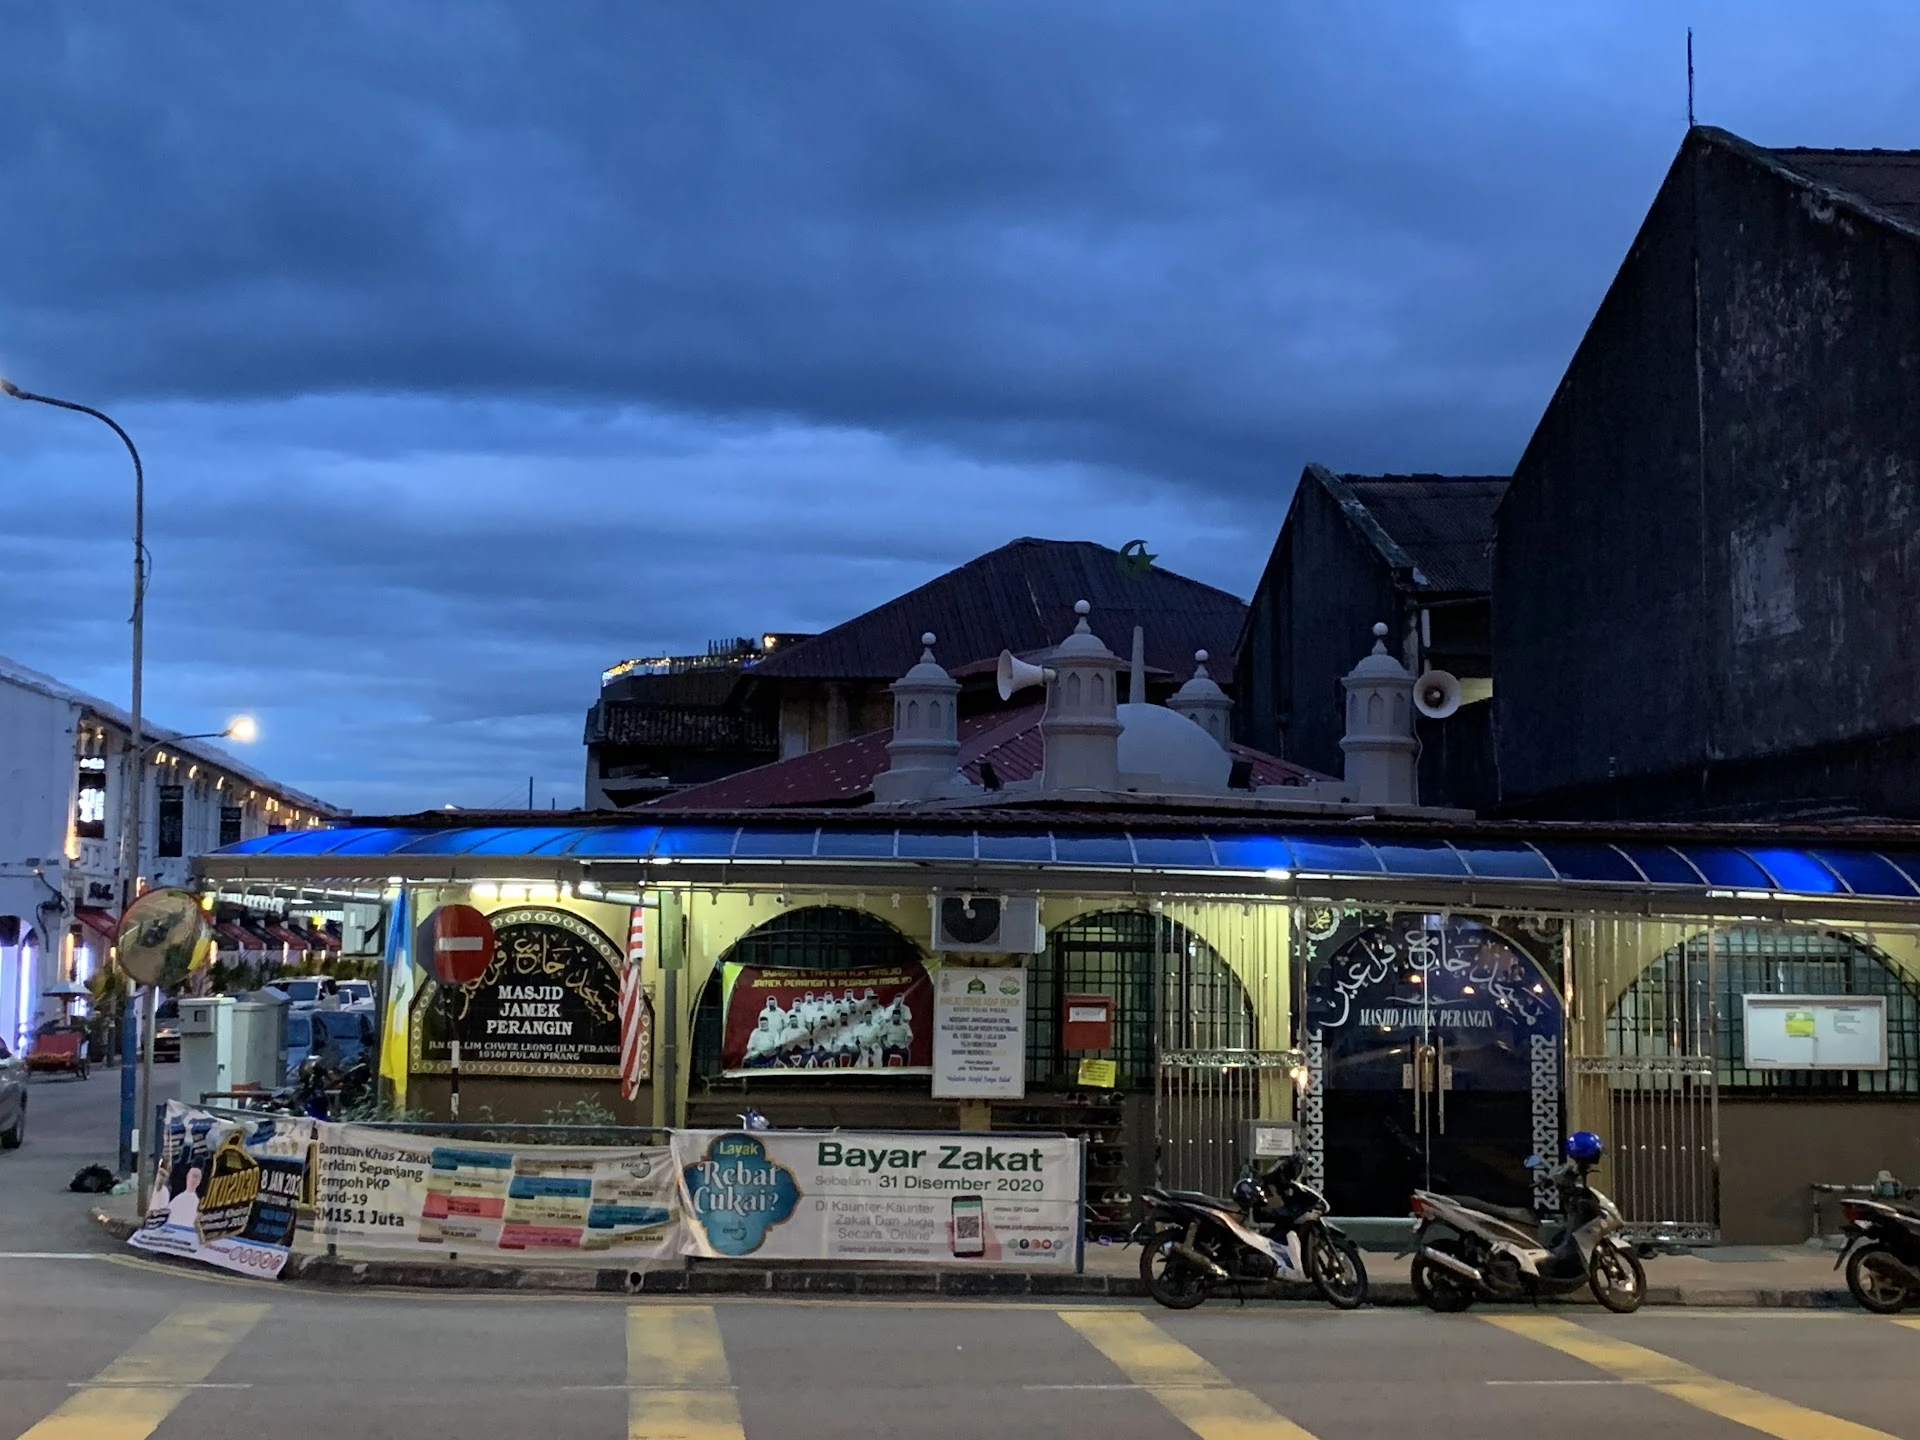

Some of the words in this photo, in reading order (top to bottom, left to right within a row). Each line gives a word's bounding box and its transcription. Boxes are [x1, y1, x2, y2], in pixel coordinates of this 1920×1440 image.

[752, 979, 782, 988] JAMEK
[784, 979, 828, 988] PERANGIN
[838, 978, 878, 987] PEGAWAI
[879, 976, 912, 985] MASJID
[498, 985, 564, 1000] MASJID
[499, 1002, 561, 1018] JAMEK
[1359, 1008, 1399, 1027] MASJID
[1399, 1008, 1437, 1028] JAMEK
[1439, 1009, 1493, 1028] PERANGIN
[486, 1019, 573, 1036] PERANGIN
[429, 1040, 444, 1050] JLN
[464, 1041, 481, 1050] LIM
[484, 1041, 518, 1051] CHWEE
[521, 1043, 553, 1052] LEONG
[555, 1043, 575, 1053] (JLN
[479, 1050, 507, 1059] 10100
[509, 1051, 541, 1060] PULAU
[543, 1052, 580, 1061] PINANG
[319, 1143, 364, 1158] Bantuan
[365, 1147, 395, 1161] Khas
[397, 1150, 432, 1165] Zakat
[719, 1142, 759, 1157] Layak
[818, 1142, 927, 1174] Bayar
[937, 1145, 1043, 1172] Zakat
[260, 1169, 268, 1190] 8
[267, 1170, 285, 1192] JAN
[359, 1161, 424, 1183] Sepanjang
[697, 1160, 780, 1190] Rebat
[317, 1173, 363, 1190] Tempoh
[366, 1177, 390, 1191] PKP
[815, 1175, 871, 1186] Sebelum
[879, 1175, 897, 1188] 31
[904, 1175, 991, 1191] Disember
[997, 1178, 1044, 1192] 2020
[693, 1186, 779, 1216] Cukai?
[815, 1200, 828, 1212] Di
[832, 1200, 935, 1213] Kaunter-Kaunter
[370, 1210, 405, 1227] Juta
[835, 1214, 871, 1226] Zakat
[875, 1215, 900, 1226] Dan
[903, 1217, 935, 1229] Juga
[838, 1228, 882, 1240] Secara
